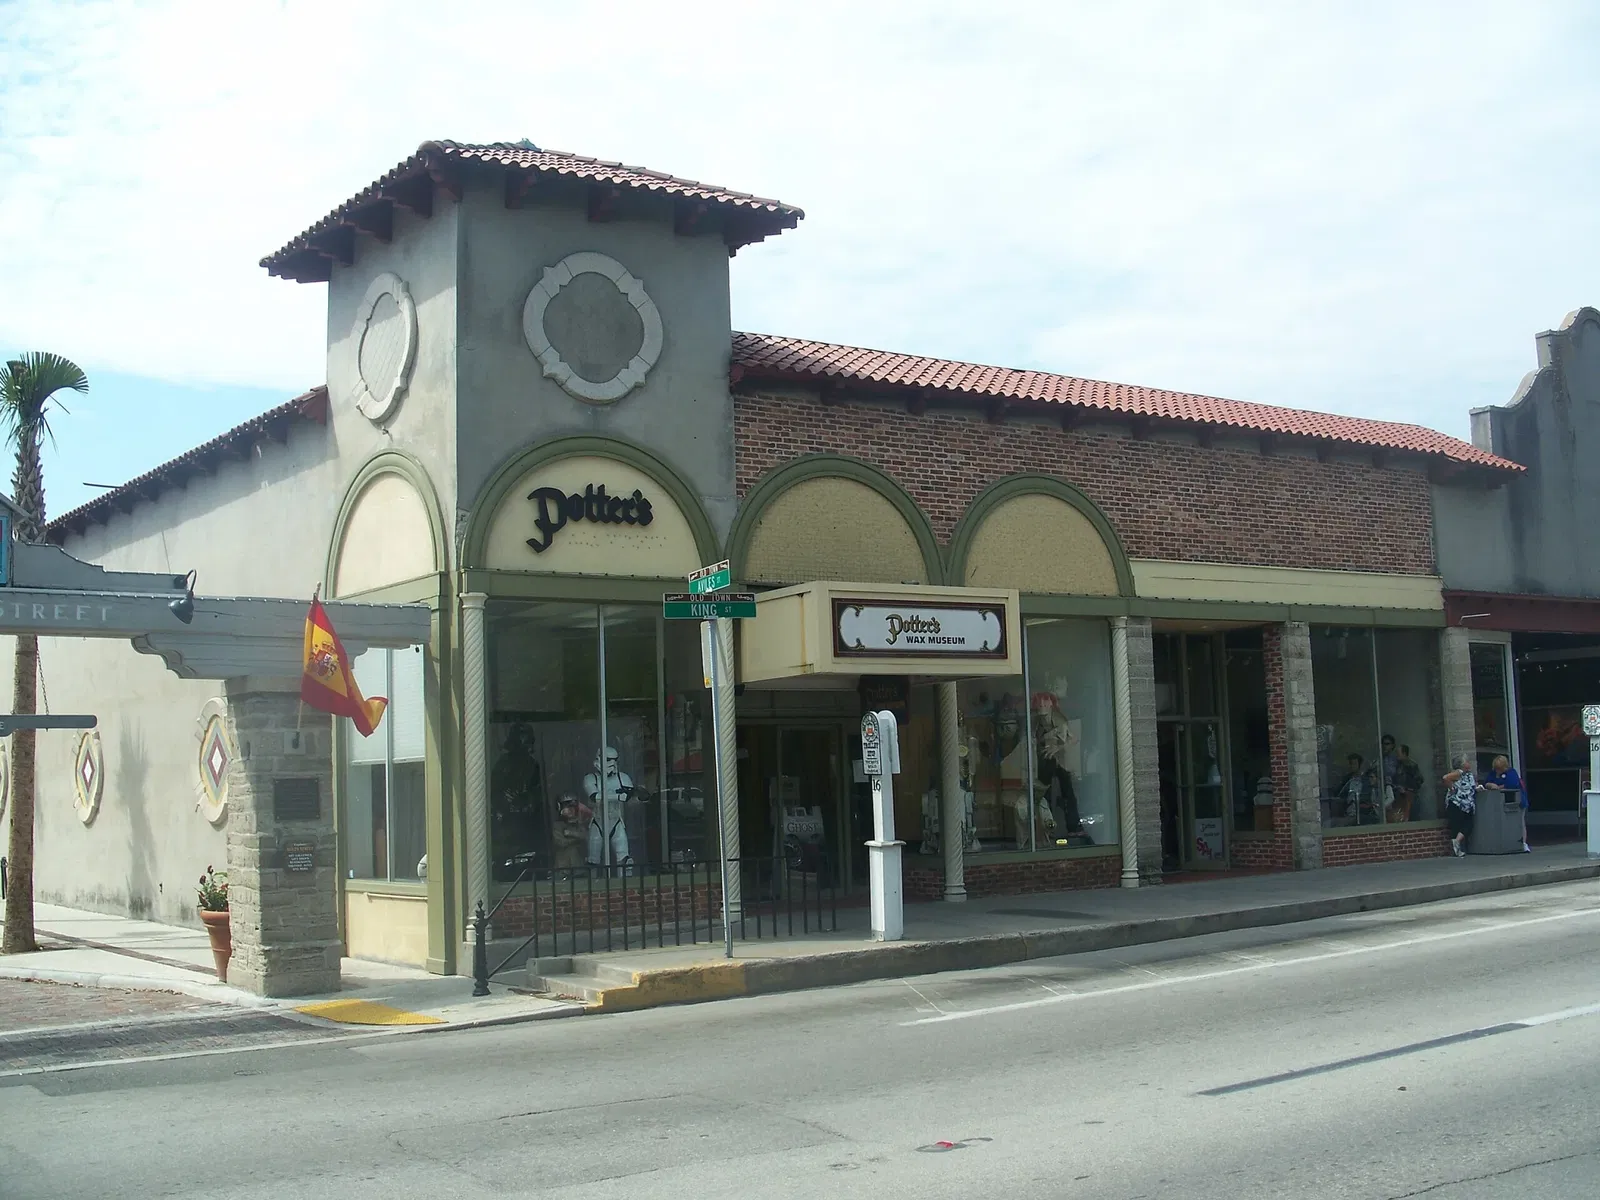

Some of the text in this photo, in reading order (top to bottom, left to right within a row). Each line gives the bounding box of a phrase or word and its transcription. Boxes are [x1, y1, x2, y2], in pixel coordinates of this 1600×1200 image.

[526, 483, 654, 553] Potter's
[698, 576, 716, 593] AVILES
[690, 594, 731, 602] OLD TOWN
[691, 603, 717, 617] KING
[885, 613, 941, 645] Potter's
[905, 635, 966, 645] WAX MUSEUM
[1591, 743, 1600, 752] 16
[872, 779, 881, 792] 16
